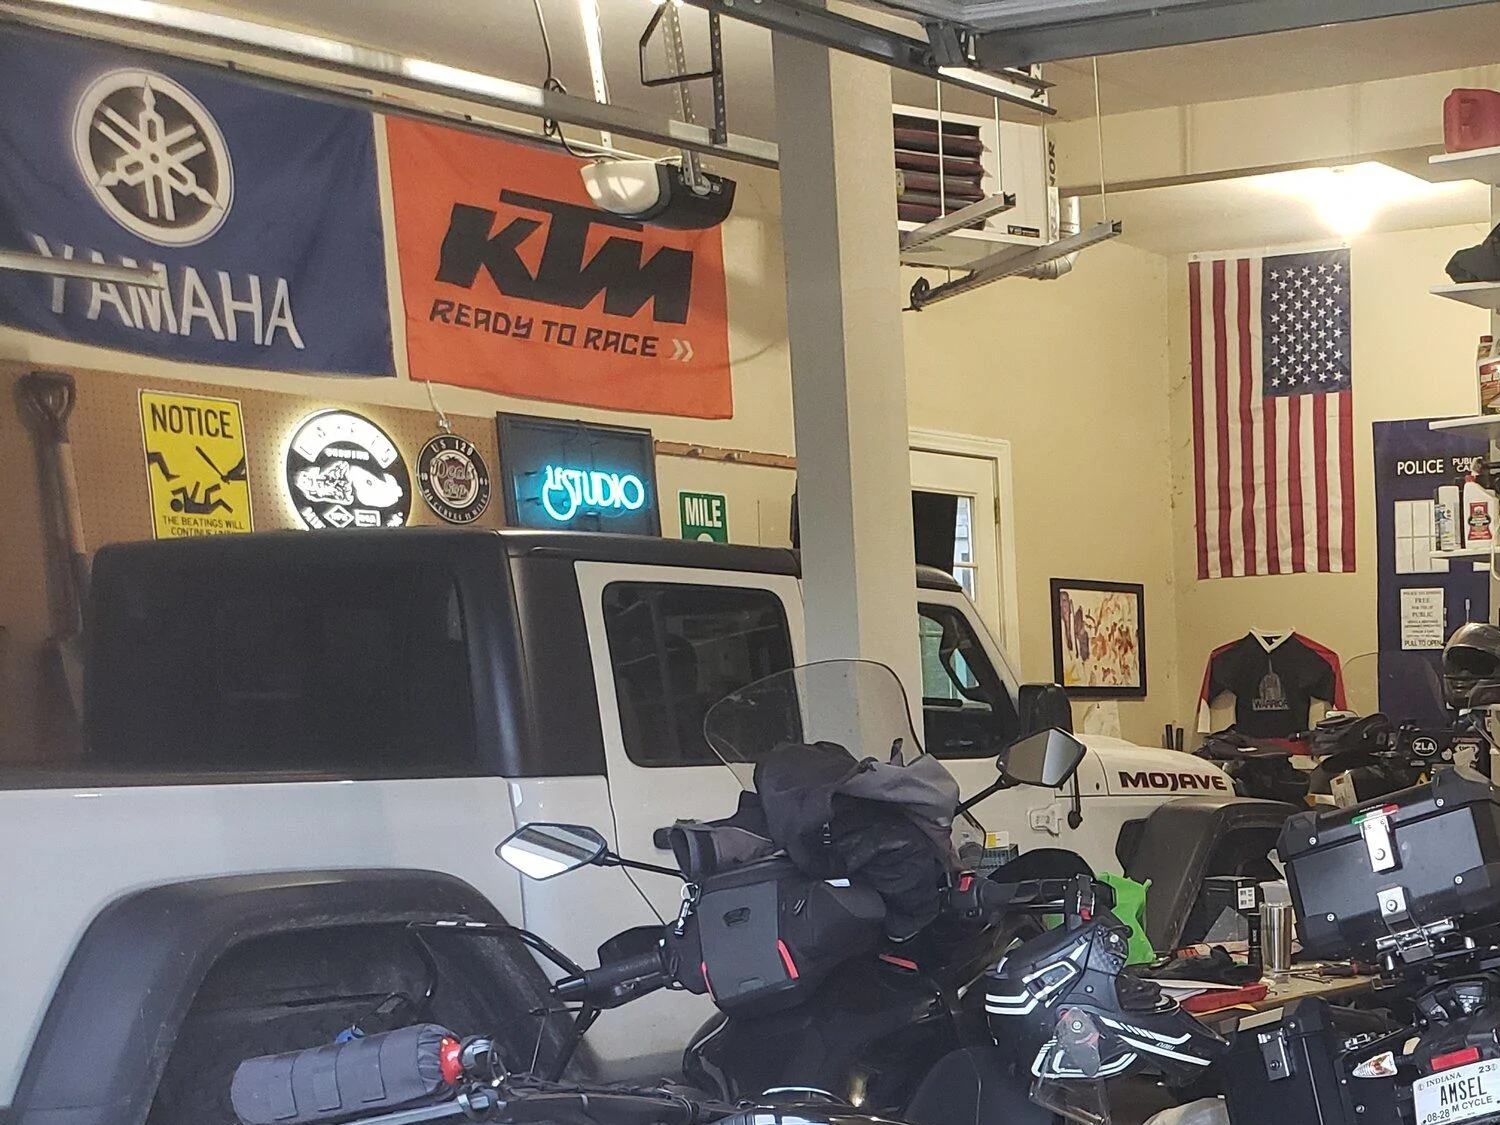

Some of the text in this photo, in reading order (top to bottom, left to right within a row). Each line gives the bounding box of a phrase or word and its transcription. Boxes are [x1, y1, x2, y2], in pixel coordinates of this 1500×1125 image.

[435, 188, 694, 325] KTM
[33, 233, 305, 349] YAMAHA
[429, 299, 660, 358] READY TO RACE
[150, 402, 234, 440] NOTICE
[431, 439, 447, 453] US
[1397, 459, 1444, 476] POLICE
[163, 515, 245, 530] THE BEATINGS WILL
[684, 497, 723, 528] MILE
[1404, 639, 1418, 647] PULL
[1414, 742, 1435, 751] ZLA
[1118, 771, 1228, 791] MOJAVE
[1426, 1064, 1491, 1088] INDIANA 23
[1440, 1075, 1488, 1106] AMSEL
[1451, 1105, 1460, 1113] M
[1461, 1095, 1493, 1110] CYCLE
